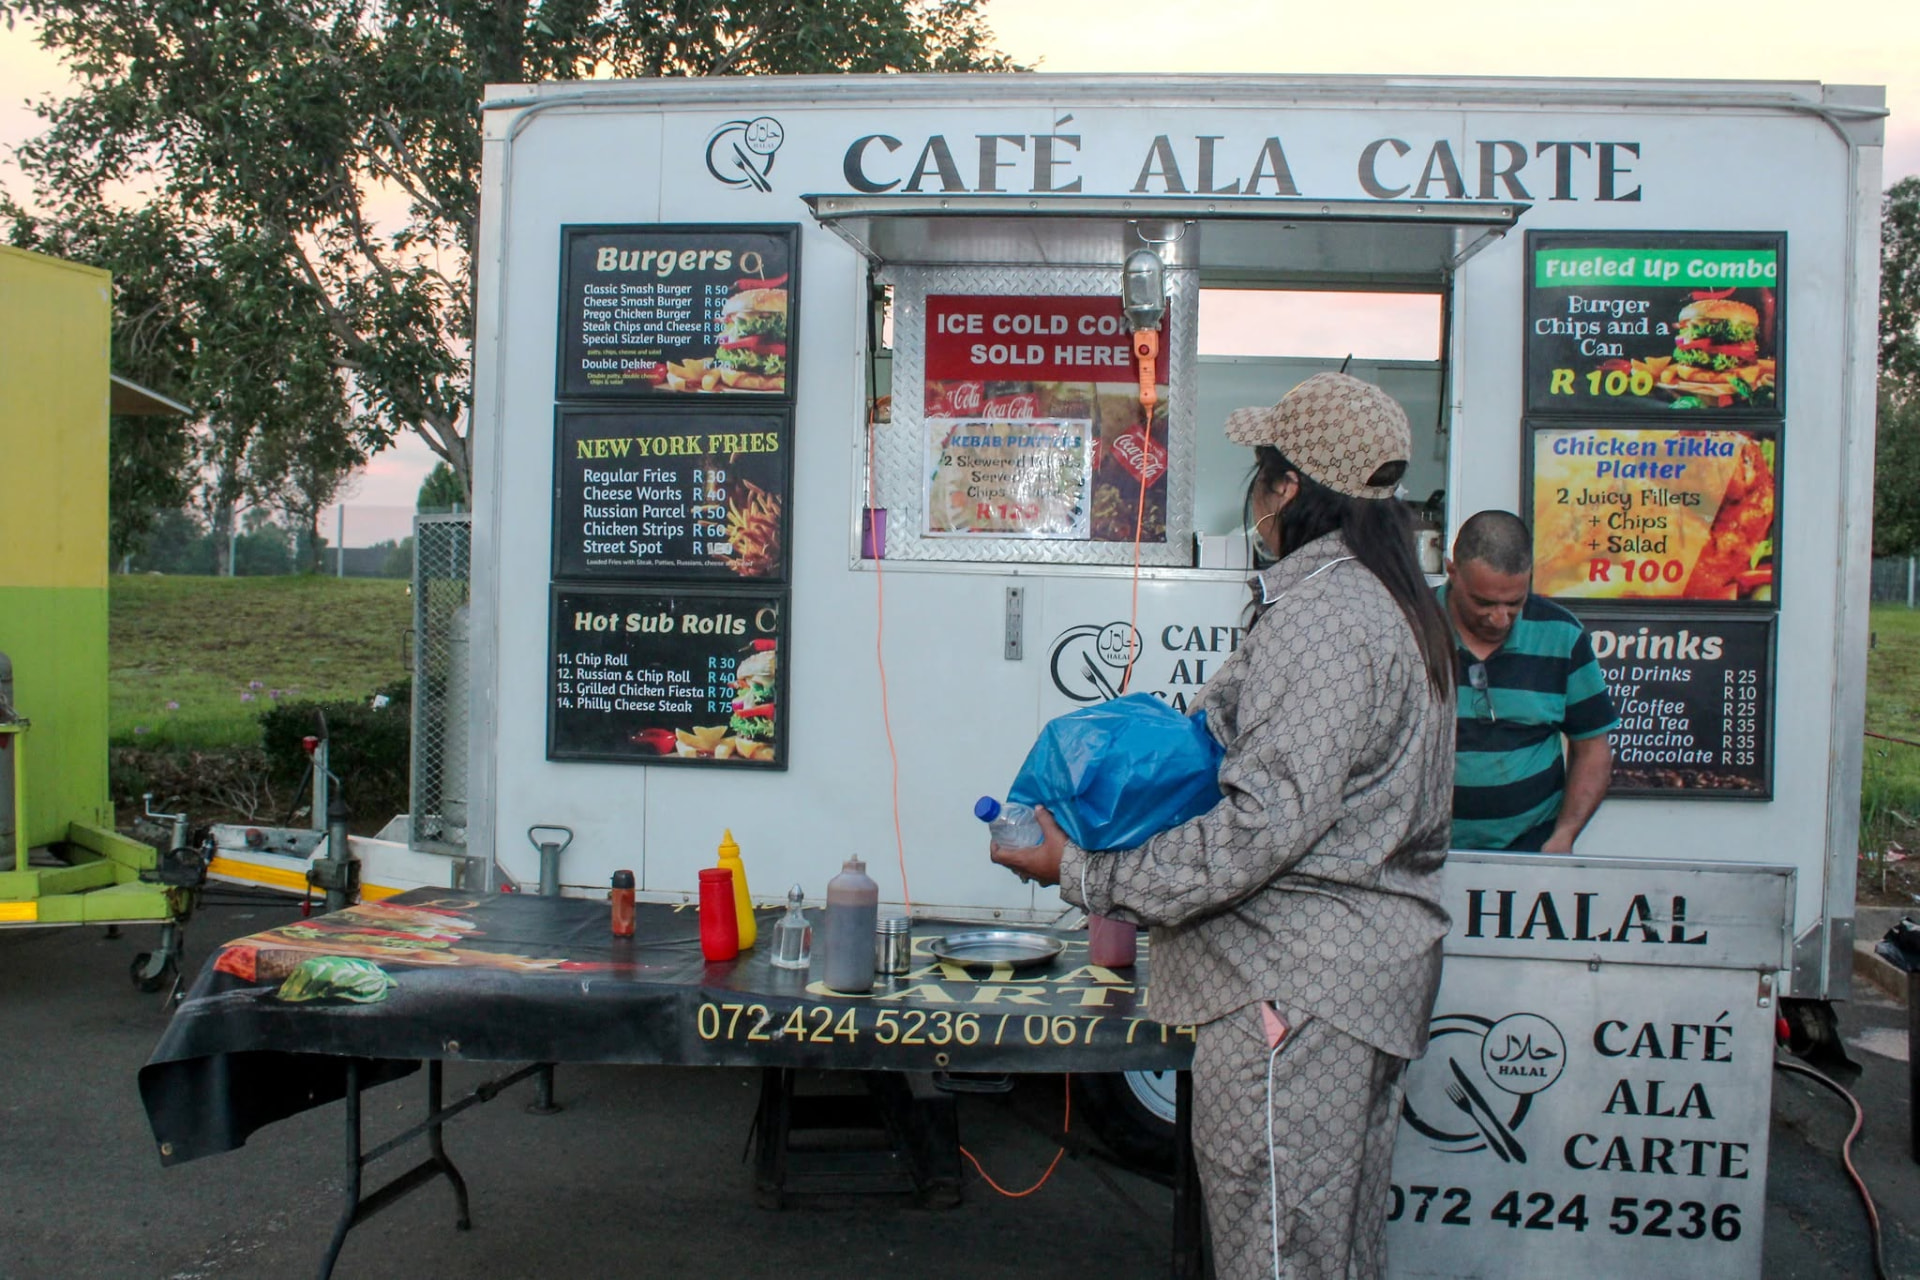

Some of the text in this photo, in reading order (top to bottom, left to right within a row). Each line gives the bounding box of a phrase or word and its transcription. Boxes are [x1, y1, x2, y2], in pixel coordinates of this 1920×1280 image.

[842, 114, 1642, 202] CAFÉ ALA CARTE
[597, 247, 732, 277] Burgers
[1546, 257, 1634, 278] Fueled
[1644, 260, 1680, 281] Up
[584, 284, 728, 297] Classic Smash Burger R 50
[584, 297, 727, 309] Cheese Smash Burger R 60
[1568, 296, 1650, 318] Burger
[583, 309, 712, 322] Prego Chicken Burger R
[938, 314, 1068, 334] ICE COLD
[583, 322, 725, 334] Steak Chips and Cheese R 80
[1536, 318, 1670, 339] Chips and a
[583, 334, 711, 346] Special Sizzler Burger R
[1581, 338, 1624, 356] Can
[971, 344, 1130, 365] SOLD HERE
[582, 358, 618, 369] Double
[621, 358, 656, 370] Dekker
[1550, 369, 1653, 396] R 100
[576, 432, 779, 459] NEW YORK FRIES
[951, 436, 1002, 448] KEBAB
[1553, 436, 1734, 458] Chicken Tikka
[944, 456, 952, 466] 2
[958, 456, 1025, 468] Skewered
[1597, 461, 1686, 479] Platter
[584, 469, 726, 485] Regular Fries R 30
[584, 486, 726, 501] Cheese Works R 40
[967, 486, 1006, 500] Chips
[1557, 488, 1701, 510] 2 Juicy Fillets
[584, 504, 726, 519] Russian Parcel R 50
[584, 522, 726, 539] Chicken Strips R 60
[1589, 512, 1667, 533] + Chips
[583, 540, 702, 557] Street Spot R
[1588, 536, 1667, 554] + Salad
[1589, 559, 1684, 583] R 100
[575, 612, 746, 635] Hot Sub Rolls
[1590, 627, 1724, 660] Drinks
[557, 654, 735, 668] 11. Chip Roll R 30
[557, 668, 735, 683] 12. Russian & Chip Roll R 40
[1631, 666, 1756, 684] Drinks R 25
[557, 683, 734, 698] 13. Grilled Chicken Fiesta R 70
[1724, 686, 1756, 700] R 10
[557, 698, 732, 713] 14. Philly Cheese Steak R 75
[1620, 698, 1684, 716] /Coffee
[1724, 703, 1733, 716] R
[1737, 703, 1756, 716] 25
[1659, 716, 1755, 732] Tea R 35
[1723, 735, 1755, 749] R 35
[1621, 748, 1713, 763] Chocolate
[1722, 752, 1732, 765] R
[1736, 752, 1754, 765] 35
[1464, 890, 1708, 944] HALAL
[895, 963, 1132, 984] ALA
[698, 1003, 1100, 1046] 072 424 5236 / 067
[1593, 1010, 1733, 1062] CAFÉ
[1498, 1065, 1548, 1078] HALAL
[1601, 1079, 1715, 1120] ALA
[1564, 1133, 1749, 1179] CARTE
[1386, 1184, 1742, 1242] 072 424 5236
